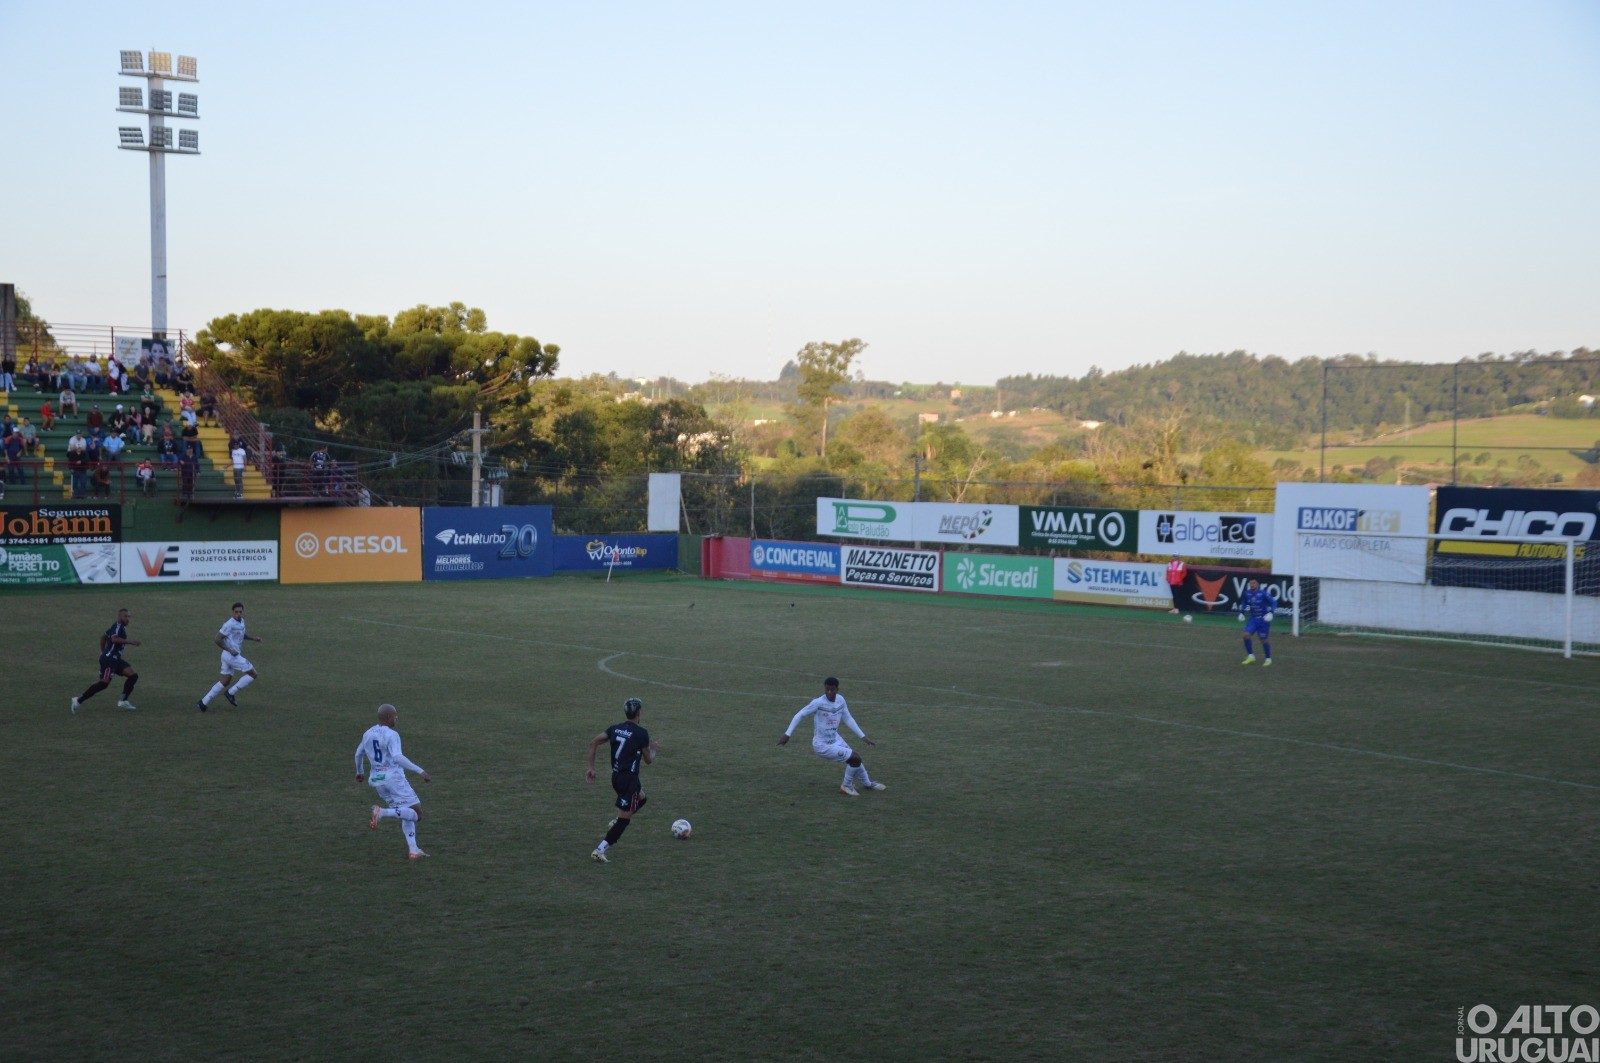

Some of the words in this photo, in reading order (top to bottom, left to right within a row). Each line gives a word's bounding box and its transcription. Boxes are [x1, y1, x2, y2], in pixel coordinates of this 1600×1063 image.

[0, 511, 113, 535] Johann
[39, 508, 109, 518] Segurança
[1302, 509, 1356, 530] BAKOF
[1439, 508, 1597, 542] CHICO
[324, 535, 408, 554] CRESOL
[1210, 545, 1255, 556] informática
[1313, 538, 1337, 549] MAIS
[1340, 539, 1392, 551] COMPLETA
[9, 560, 60, 571] PERETTO
[766, 547, 836, 568] CONCREVAL
[846, 549, 937, 571] MAZZONETTO
[847, 569, 878, 581] Peças
[887, 572, 934, 586] Serviços
[979, 563, 1039, 589] Sicredi
[1084, 567, 1158, 586] STEMETAL
[373, 739, 383, 763] 6
[616, 735, 627, 759] 7
